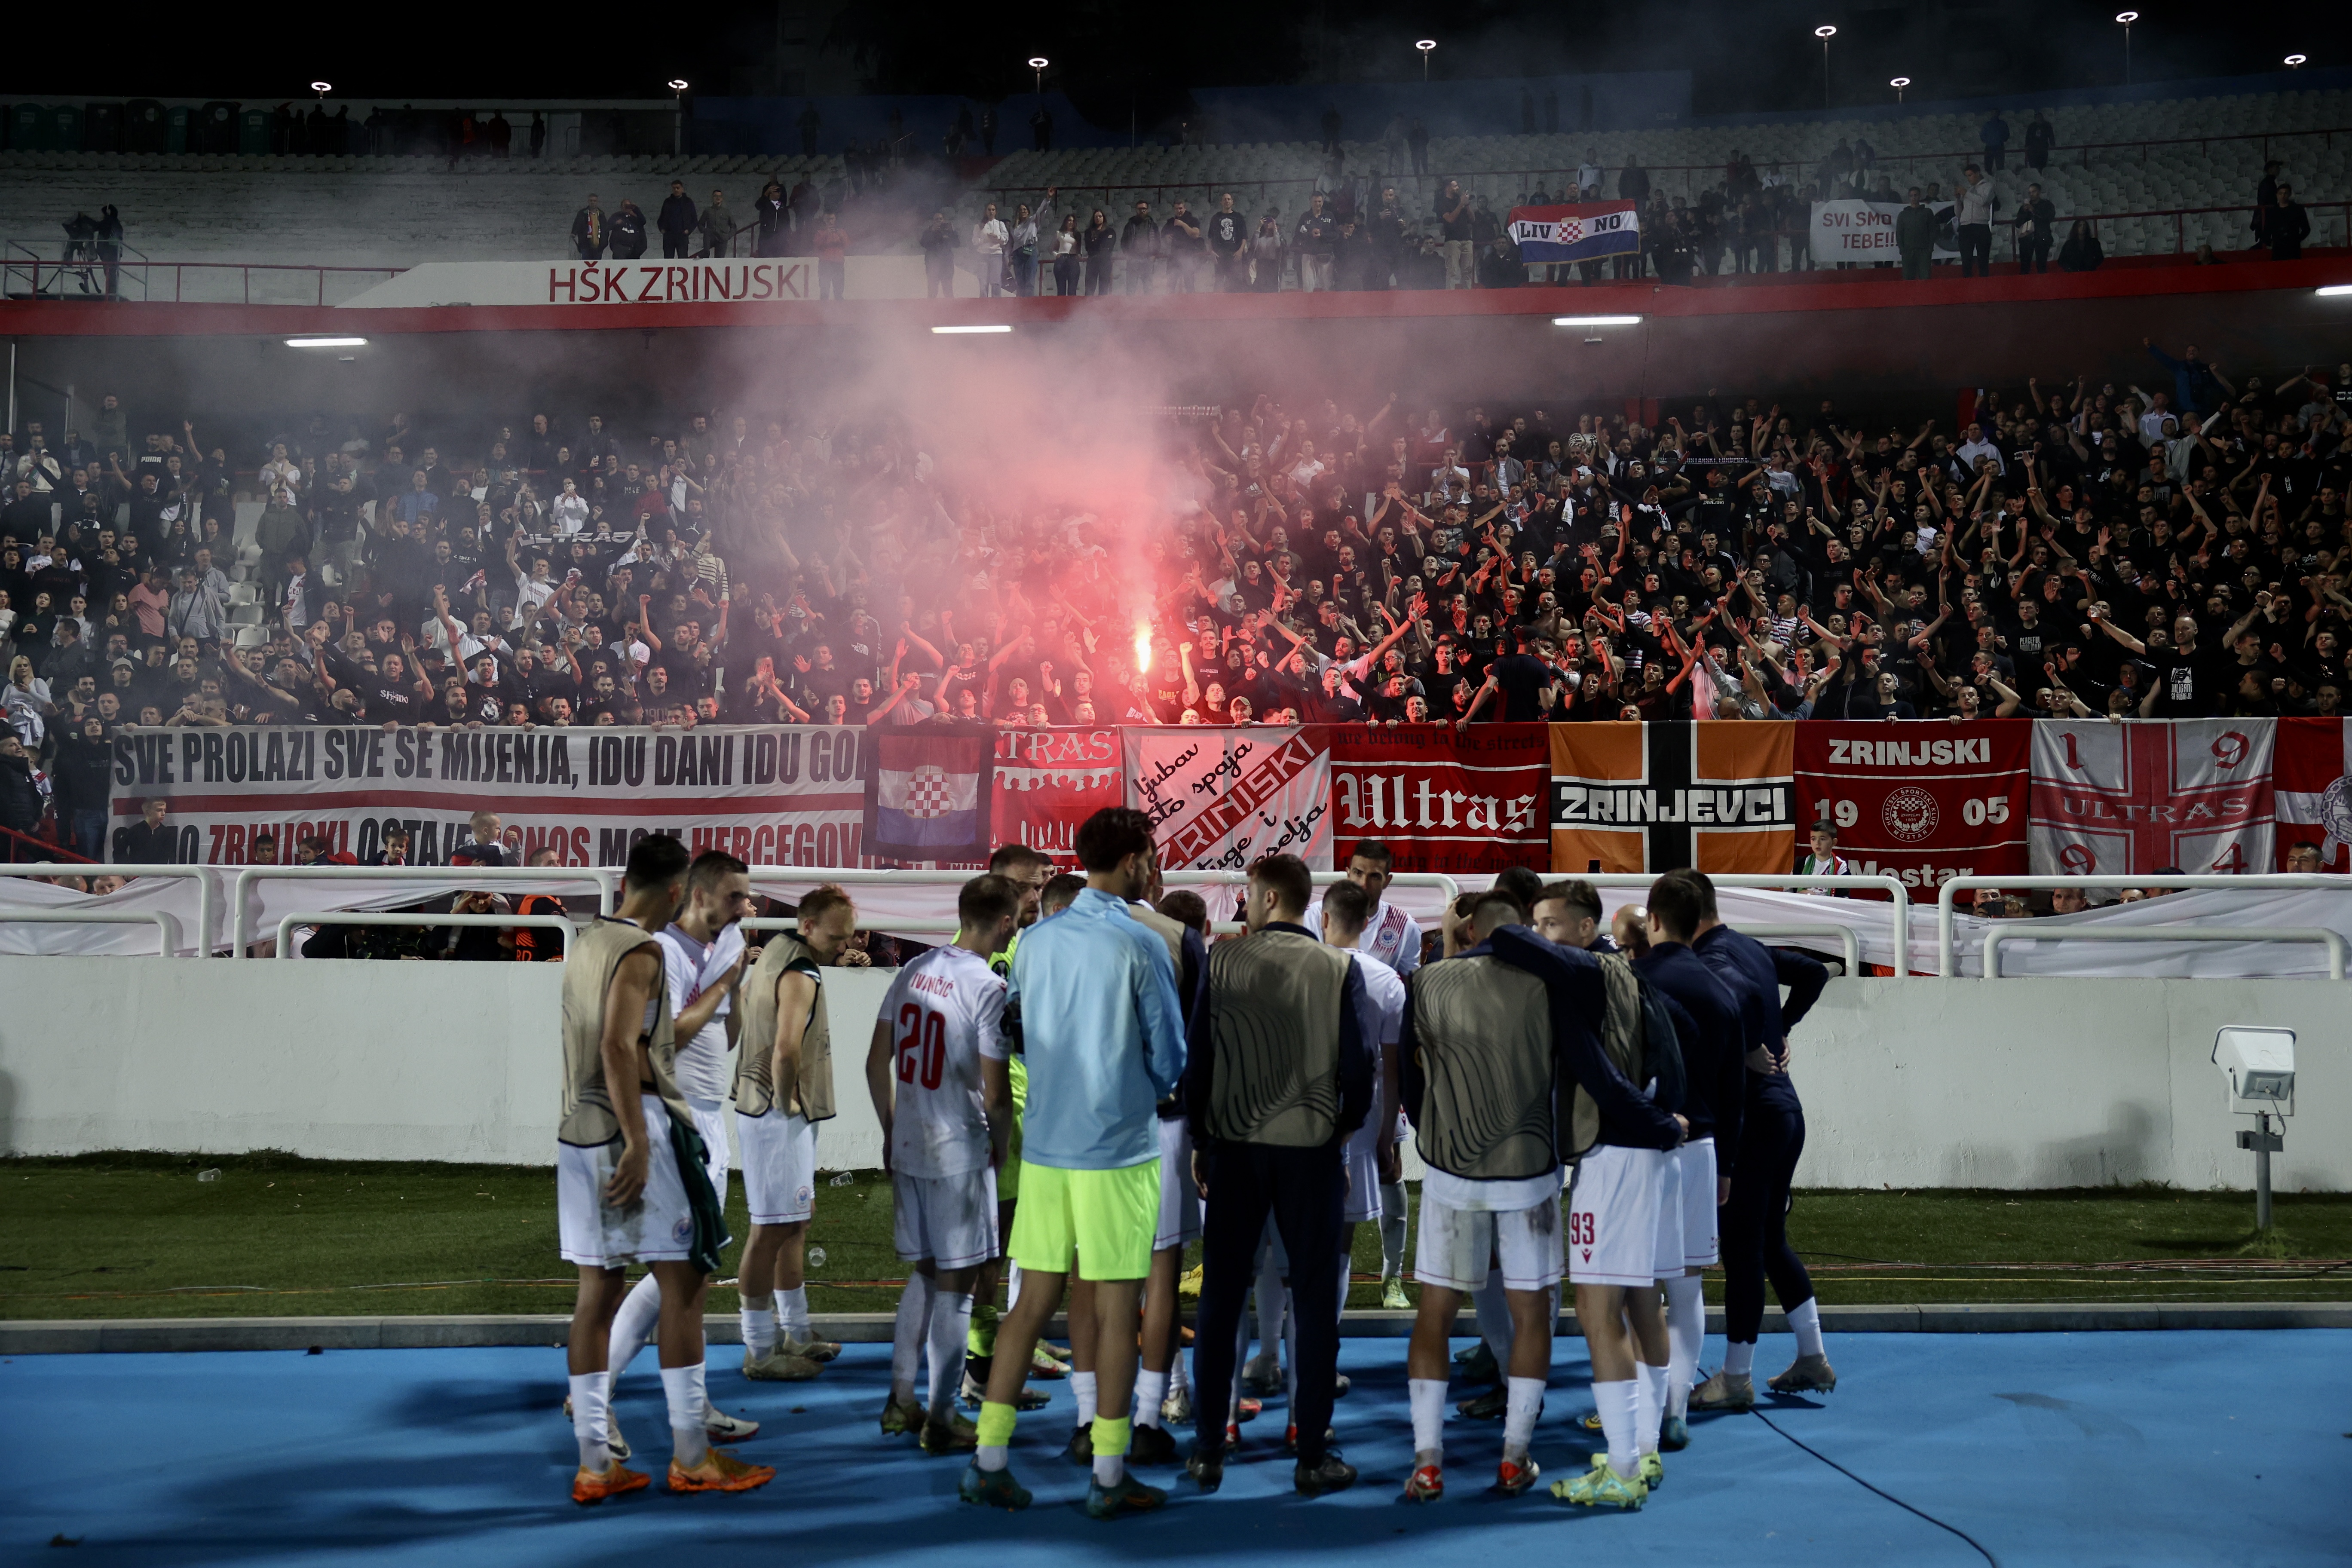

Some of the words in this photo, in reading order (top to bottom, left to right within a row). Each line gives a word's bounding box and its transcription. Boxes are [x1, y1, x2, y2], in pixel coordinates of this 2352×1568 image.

[1520, 223, 1551, 239] LIV
[1594, 215, 1620, 233] NO
[1823, 213, 1849, 227] SVI
[1856, 211, 1892, 227] SMO
[1842, 233, 1899, 248] TEBE!!
[550, 261, 628, 302] HŠK
[640, 264, 809, 301] ZRINJSKI
[518, 532, 634, 547] ULTRAS
[2020, 637, 2040, 645] PEACEFUL
[994, 730, 1114, 763] TRAS
[1338, 732, 1362, 745] we
[1368, 729, 1425, 749] belong
[1433, 731, 1449, 744] to
[1454, 730, 1480, 750] the
[1487, 733, 1545, 750] streets
[1828, 738, 1991, 766] ZRINJSKI
[2211, 732, 2250, 770] 9
[115, 734, 174, 786] SVE
[183, 730, 315, 783] PROLAZI
[324, 728, 385, 779] SVE
[395, 729, 432, 778] SE
[441, 730, 579, 790] MIJENJA,
[588, 736, 646, 787] IDU
[654, 735, 733, 785] DANI
[743, 733, 801, 784] IDU
[1133, 743, 1198, 803] ljubav
[1192, 742, 1253, 796] spaja
[1157, 734, 1316, 871] ZRINJSKI
[1336, 773, 1537, 833] Ultras
[1561, 787, 1785, 822] ZRINJEVCI
[1815, 799, 1858, 827] 19
[1963, 796, 2009, 826] 05
[1884, 793, 1899, 826] HRVATSKI
[1900, 789, 1933, 805] ŠPORTSKI
[2063, 796, 2249, 824] ULTRAS
[1259, 811, 1277, 827] i
[1893, 830, 1928, 839] MOSTAR
[504, 825, 590, 867] ONOS
[2059, 843, 2096, 875] 9
[2211, 842, 2248, 874] 4
[911, 972, 954, 998] IVANČIĆ
[899, 1002, 946, 1090] 20
[1571, 1212, 1595, 1245] 93
